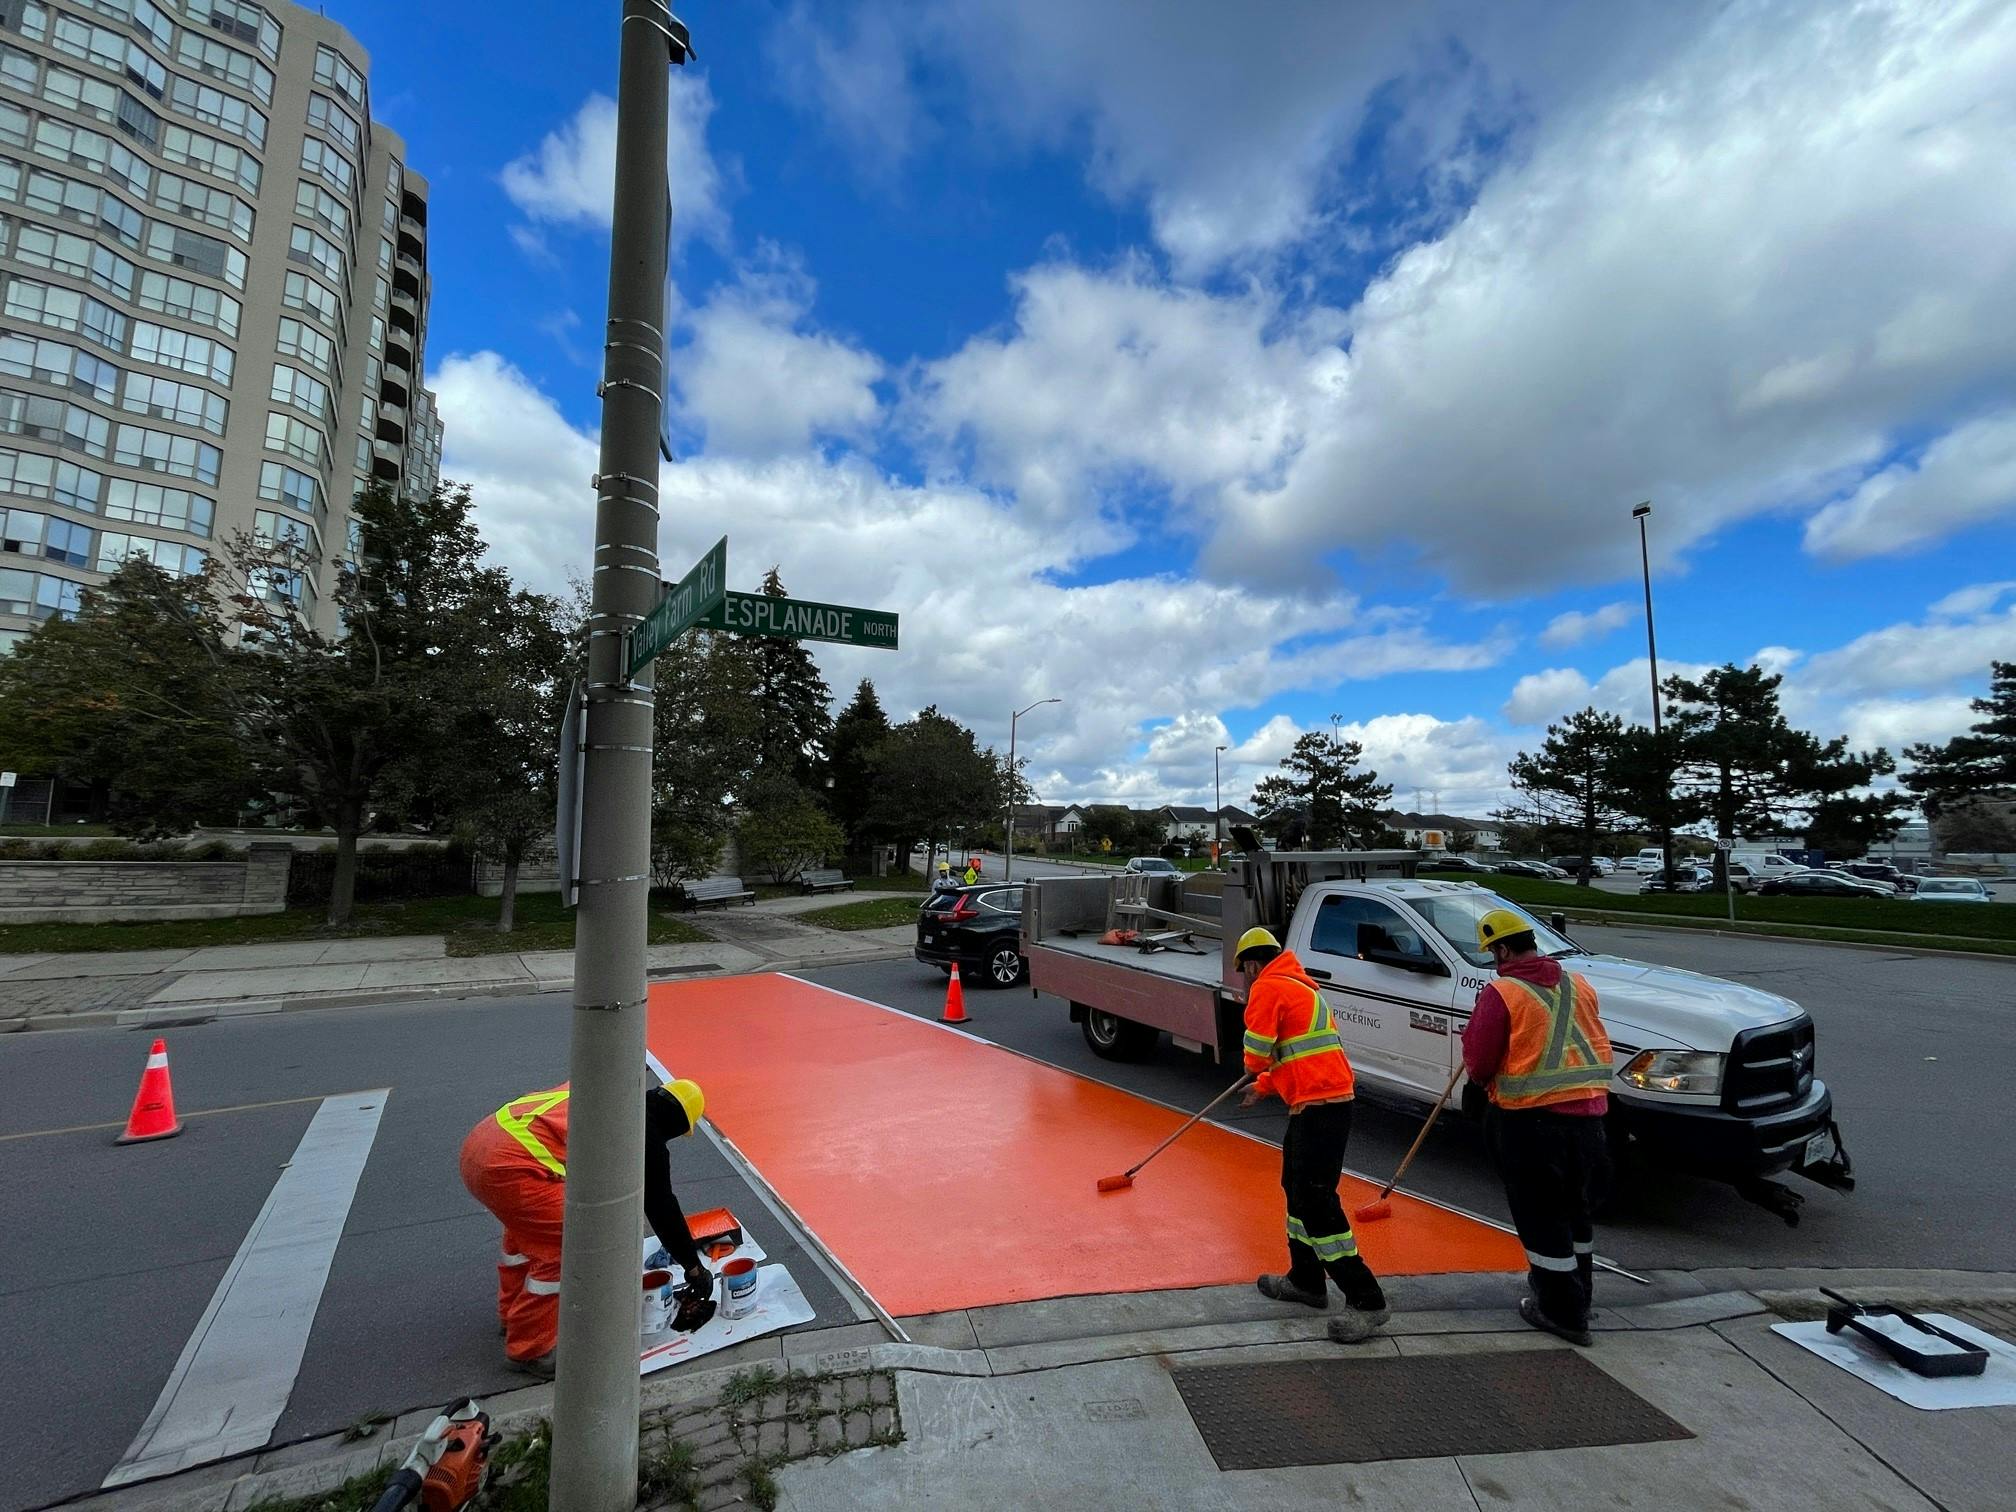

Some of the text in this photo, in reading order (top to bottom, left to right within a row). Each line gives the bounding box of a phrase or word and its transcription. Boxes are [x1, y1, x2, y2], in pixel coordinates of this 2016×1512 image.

[632, 551, 716, 662] Valley Farm Rd
[724, 597, 897, 639] ESPLANADE NORTH
[1333, 1009, 1381, 1029] PICKERING
